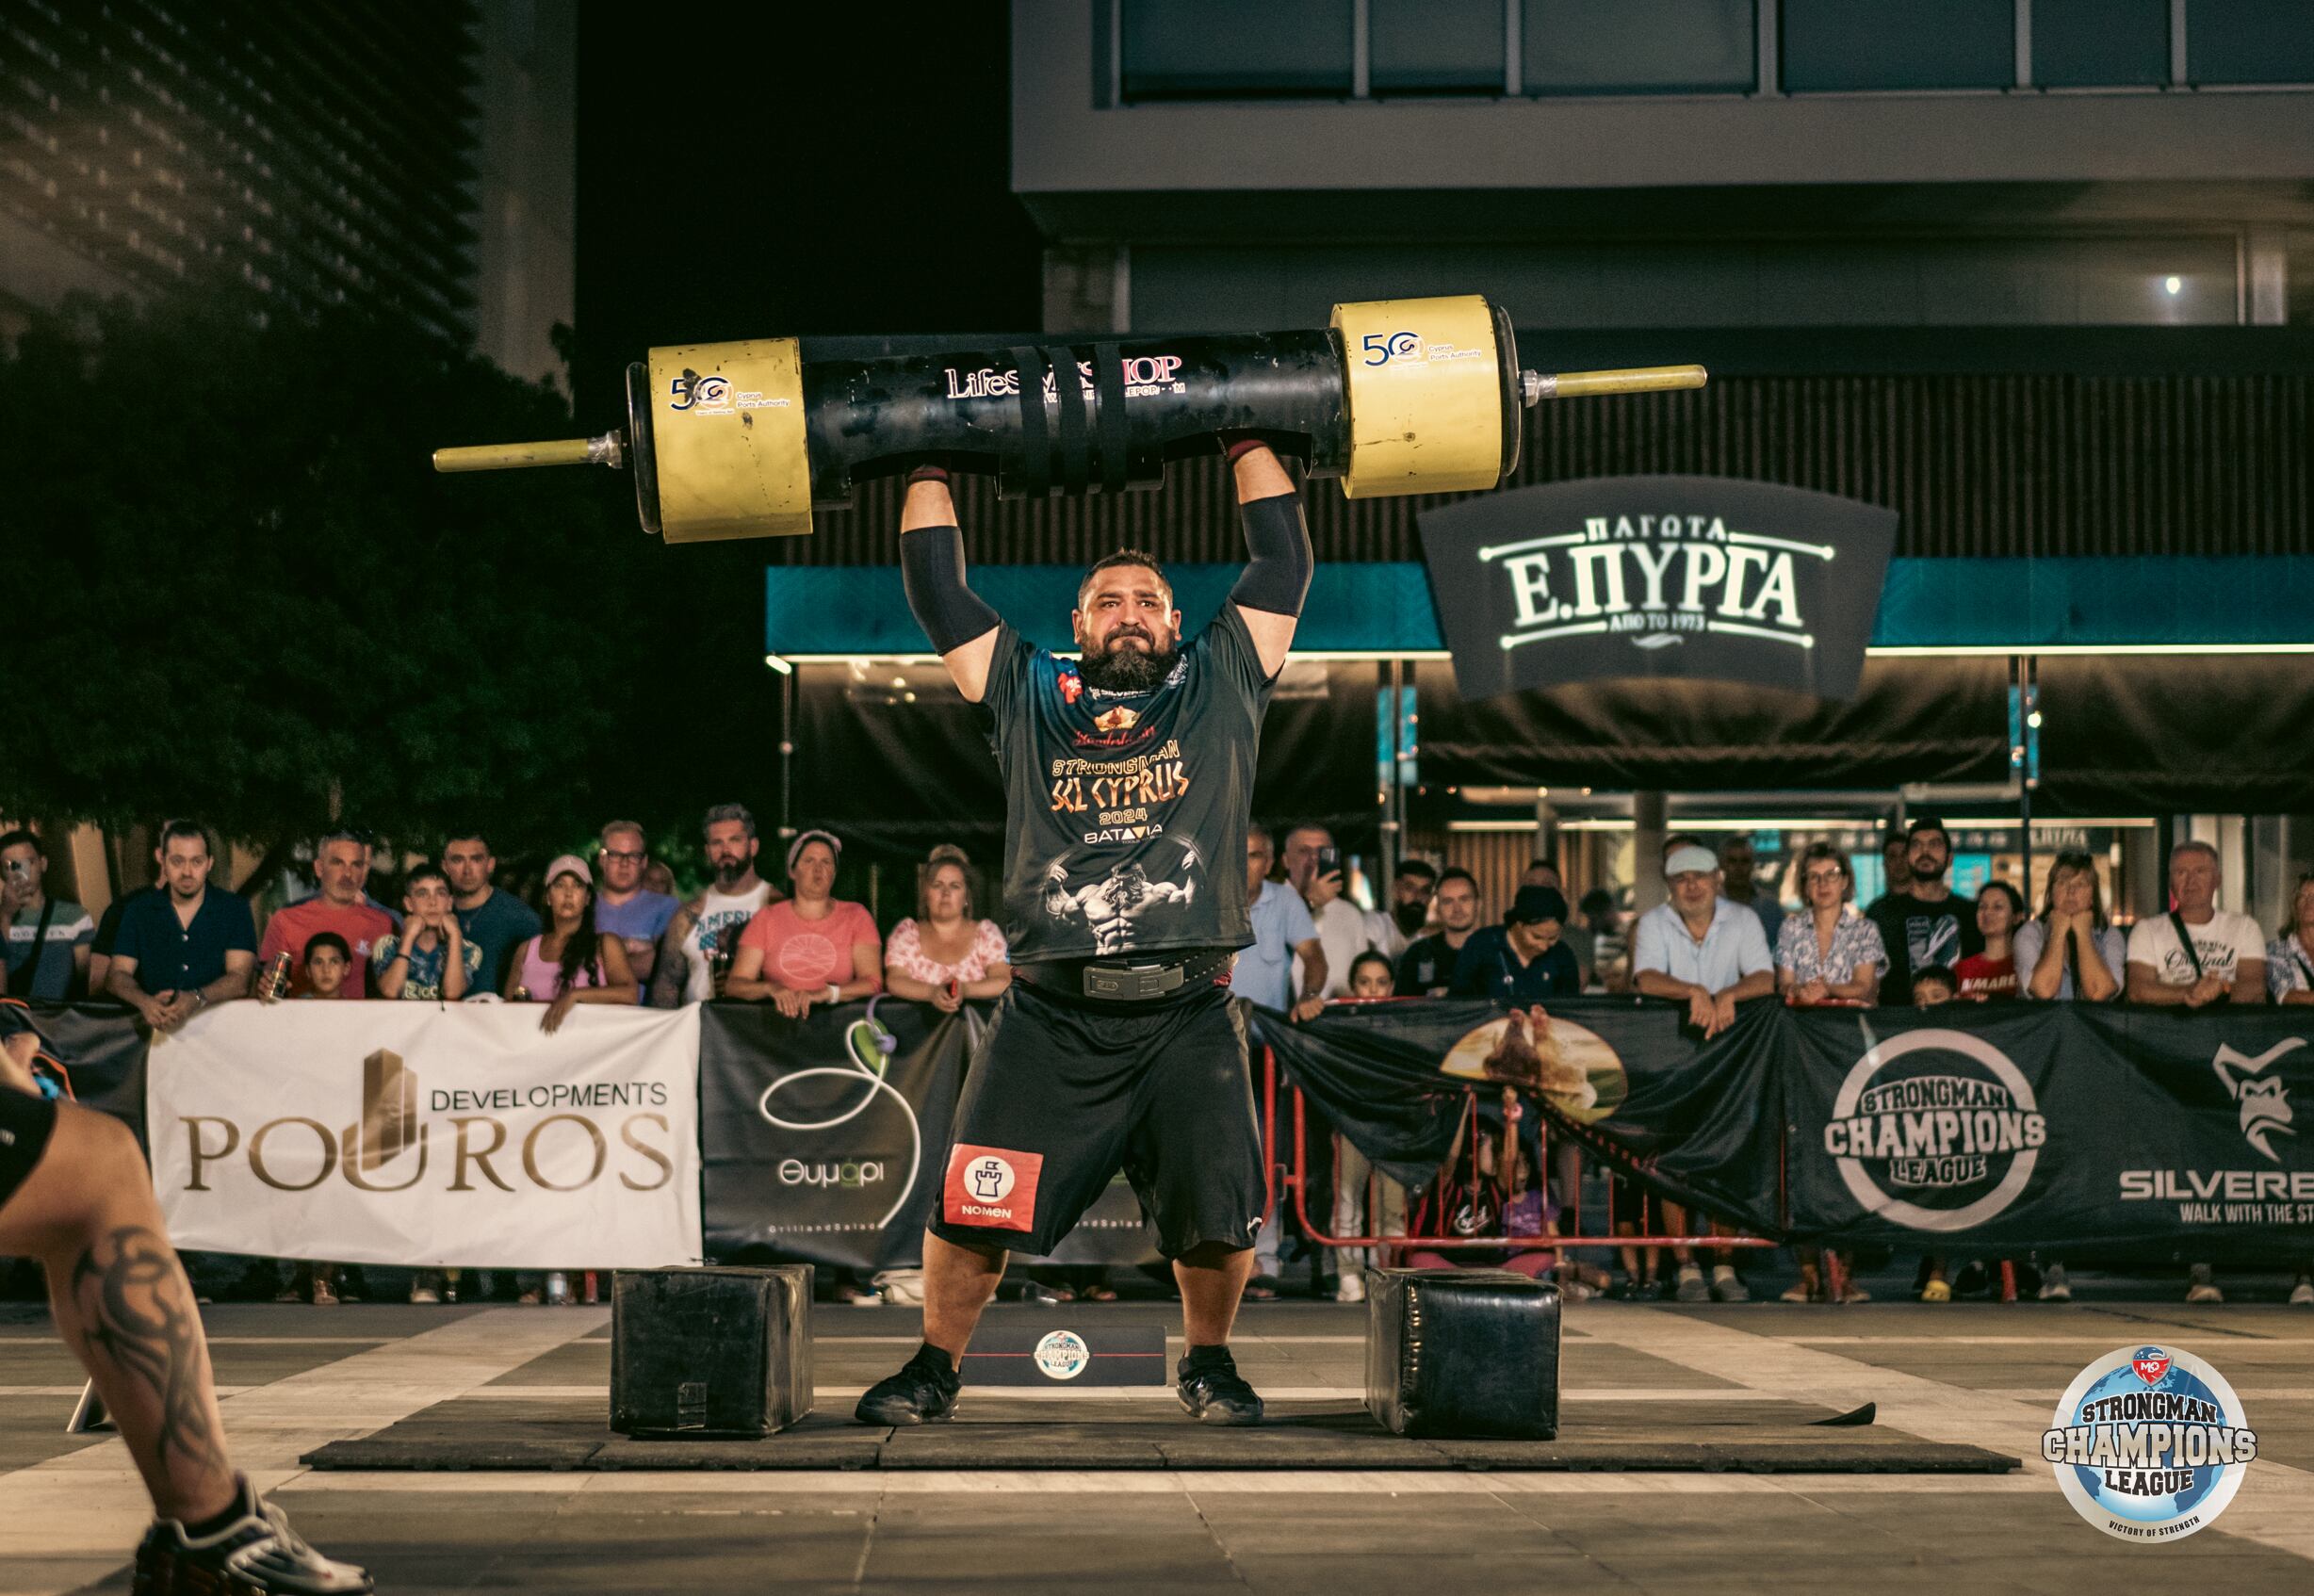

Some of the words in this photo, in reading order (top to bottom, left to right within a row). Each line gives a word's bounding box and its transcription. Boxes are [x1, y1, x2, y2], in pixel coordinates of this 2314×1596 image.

[1428, 345, 1454, 353] Cyprus
[1450, 350, 1481, 360] Authority
[737, 392, 761, 400] Cyprus
[758, 399, 790, 408] Authority
[1051, 740, 1181, 776] STRONGMAN
[1051, 777, 1088, 813] SCL
[1091, 760, 1190, 809] CYPRUS
[1099, 807, 1148, 826] 2024
[1084, 823, 1163, 844] BATAVIA
[431, 1083, 667, 1111] DEVELOPMENTS
[1863, 1076, 2008, 1113] STRONGMAN
[1824, 1110, 2046, 1157] CHAMPIONS
[179, 1112, 675, 1192] POUROS
[1892, 1157, 1986, 1184] LEAGUE
[2179, 1203, 2222, 1223] WALK
[2224, 1203, 2261, 1223] WITH
[2264, 1203, 2293, 1223] THE
[2297, 1203, 2314, 1223] ST
